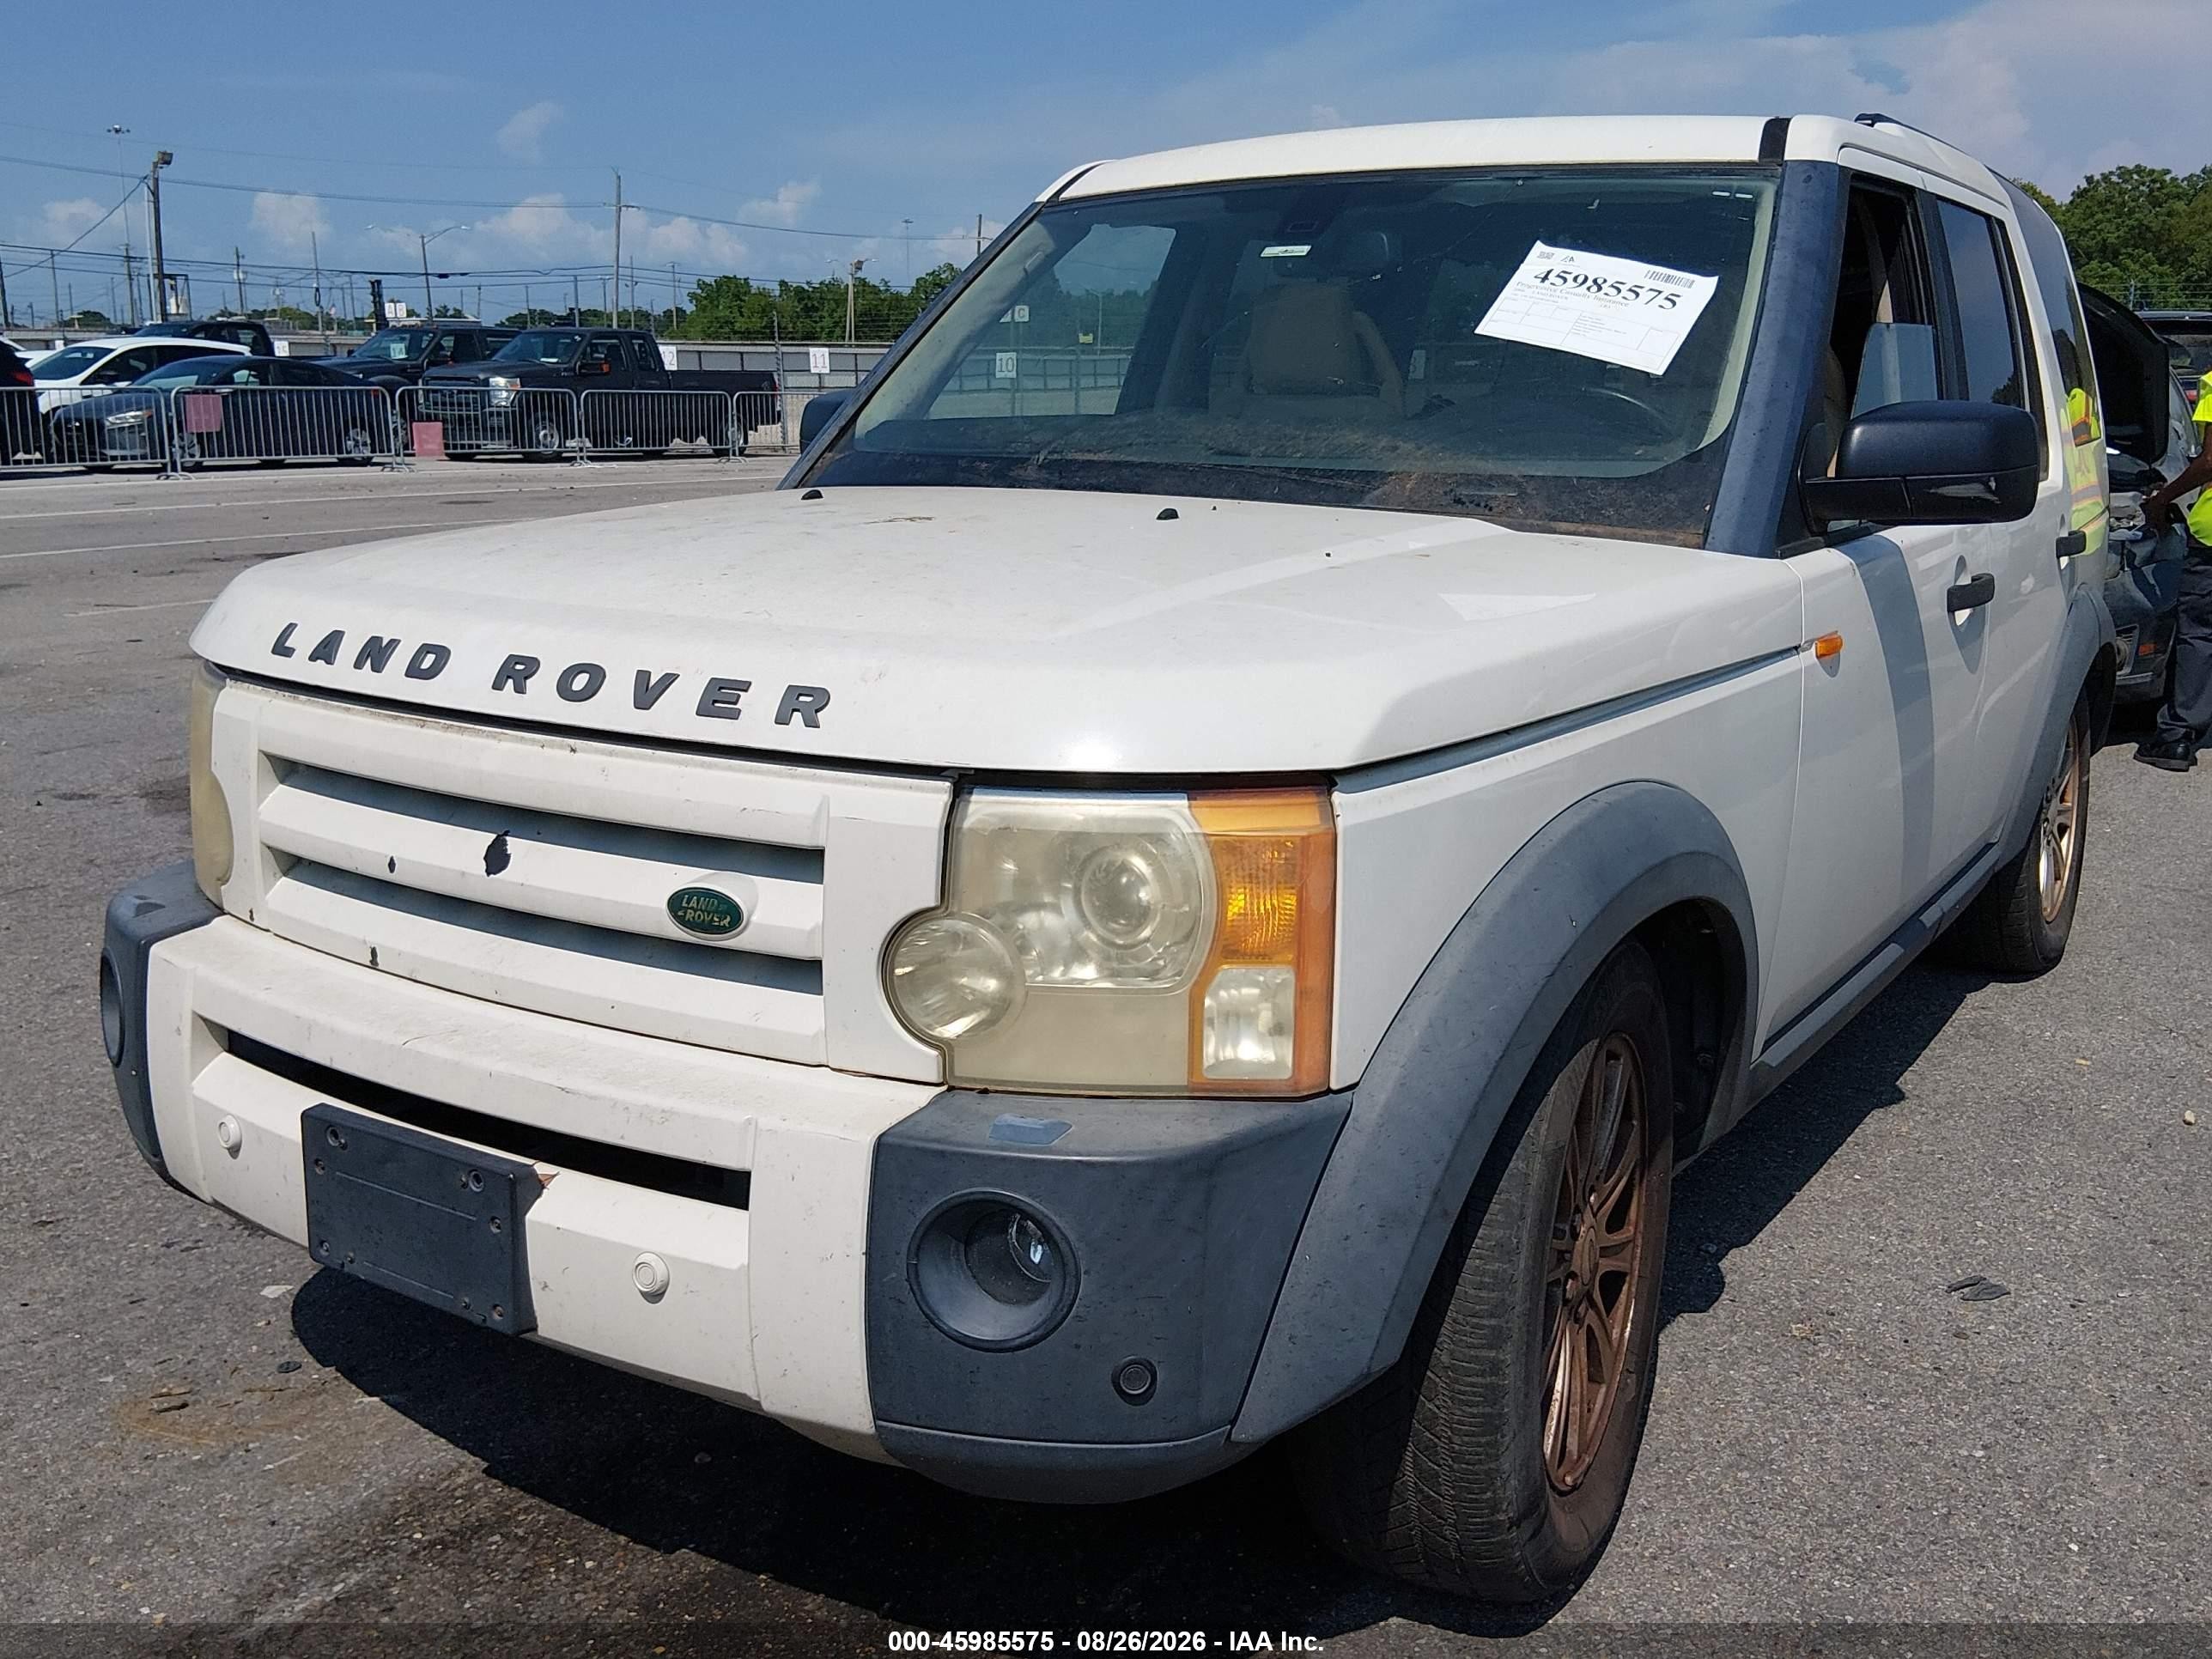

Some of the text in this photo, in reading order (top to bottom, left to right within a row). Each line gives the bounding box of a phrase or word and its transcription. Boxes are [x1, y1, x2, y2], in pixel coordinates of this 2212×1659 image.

[1534, 268, 1683, 310] 45985575
[1018, 308, 1025, 319] C
[812, 353, 828, 368] 11
[998, 356, 1015, 373] 10
[270, 622, 831, 729] LAND ROVER
[682, 895, 718, 910] LAND
[685, 909, 731, 927] ROVER
